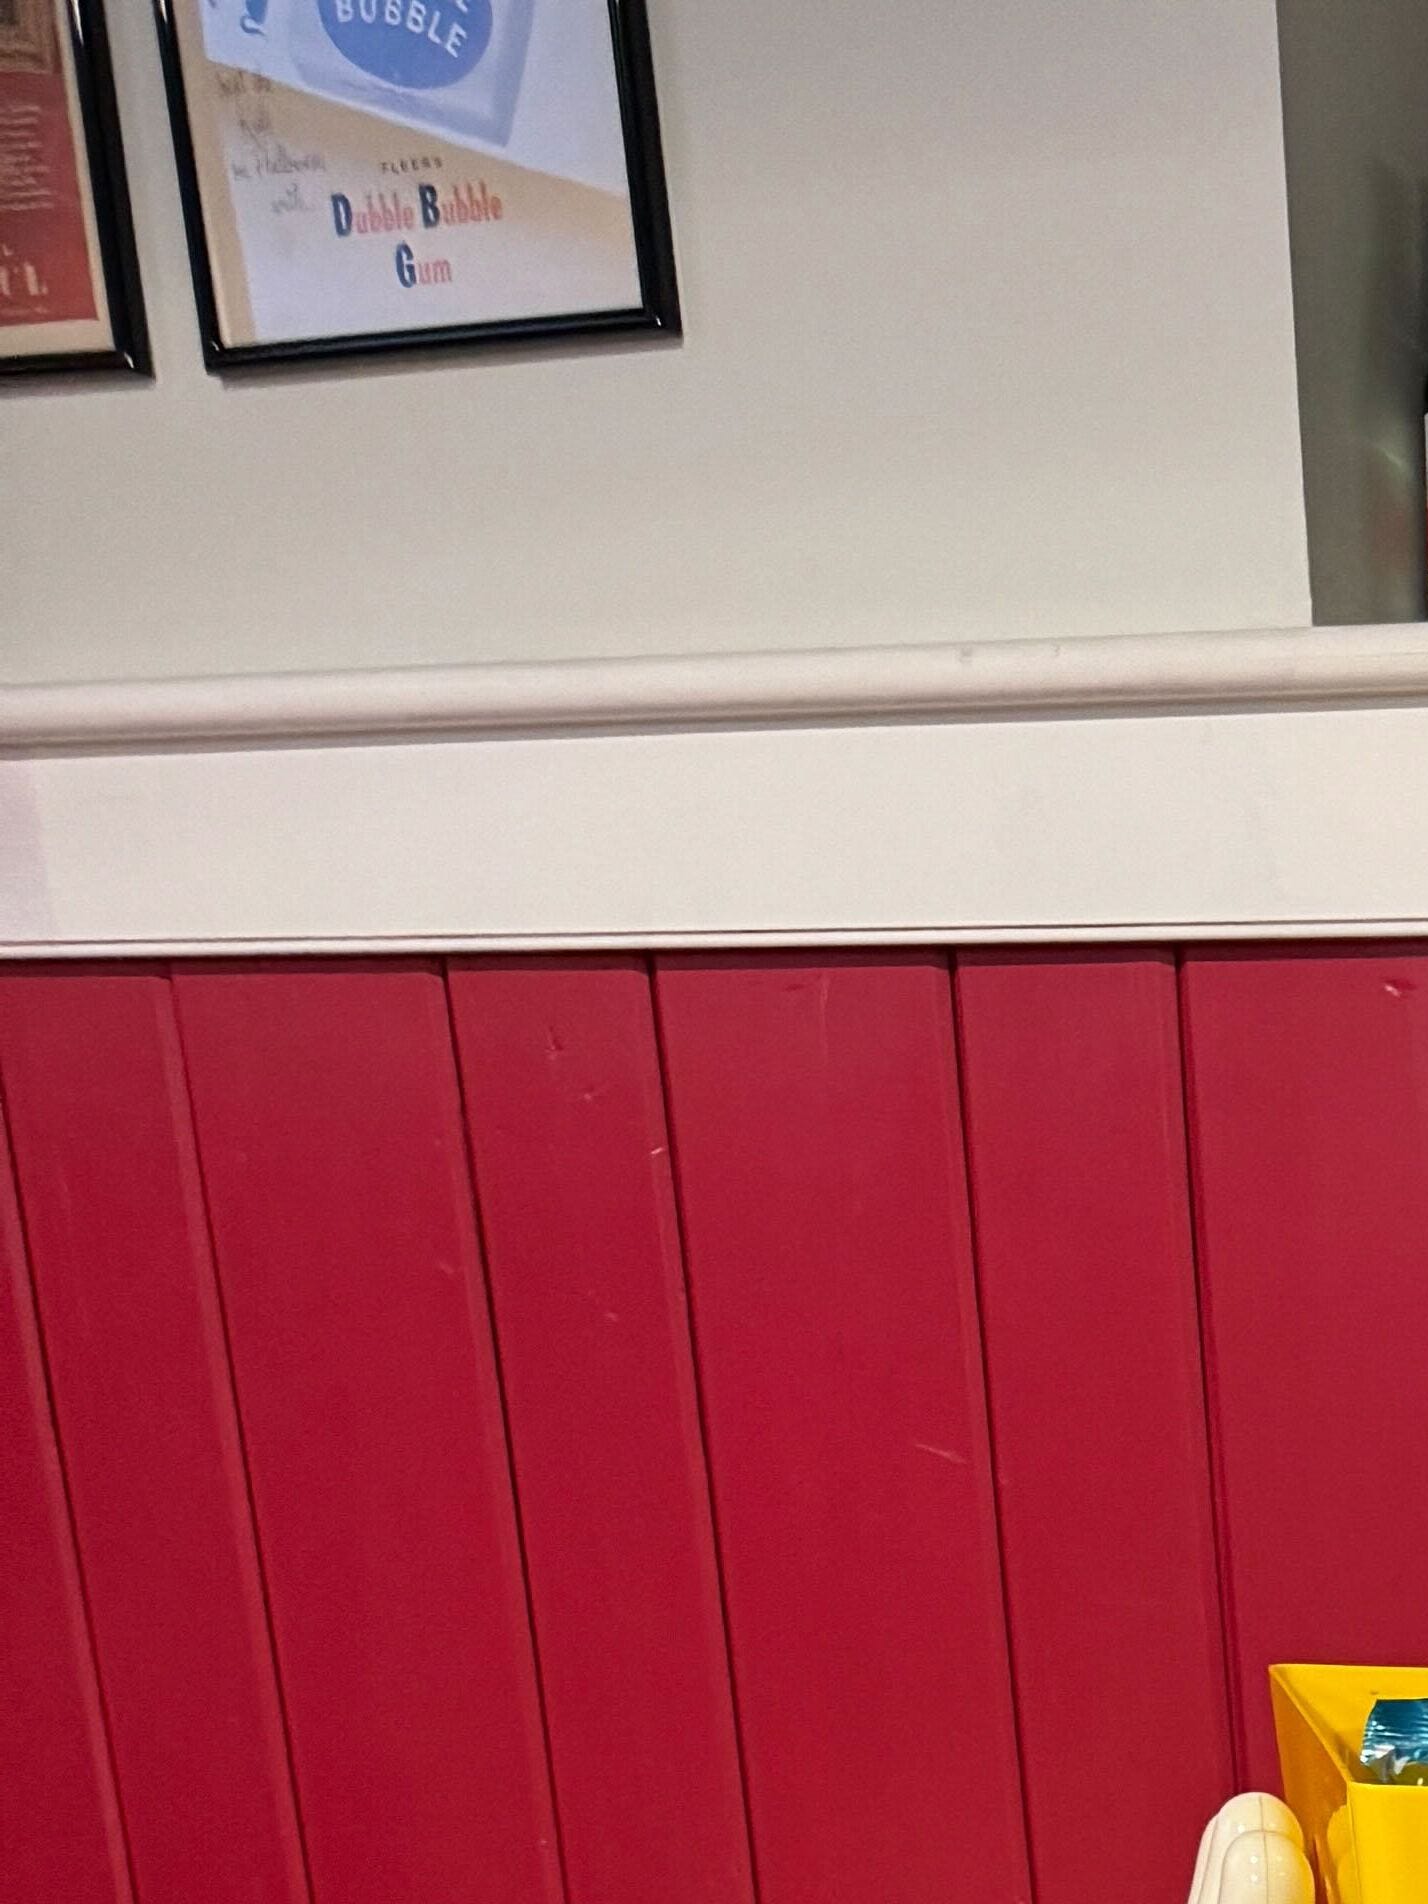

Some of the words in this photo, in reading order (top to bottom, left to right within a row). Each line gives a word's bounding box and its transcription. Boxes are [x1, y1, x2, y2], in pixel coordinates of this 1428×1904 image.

[335, 0, 467, 58] BUBBLE
[330, 191, 415, 237] Dubble
[418, 178, 504, 229] Bubble
[395, 240, 453, 288] Gum
